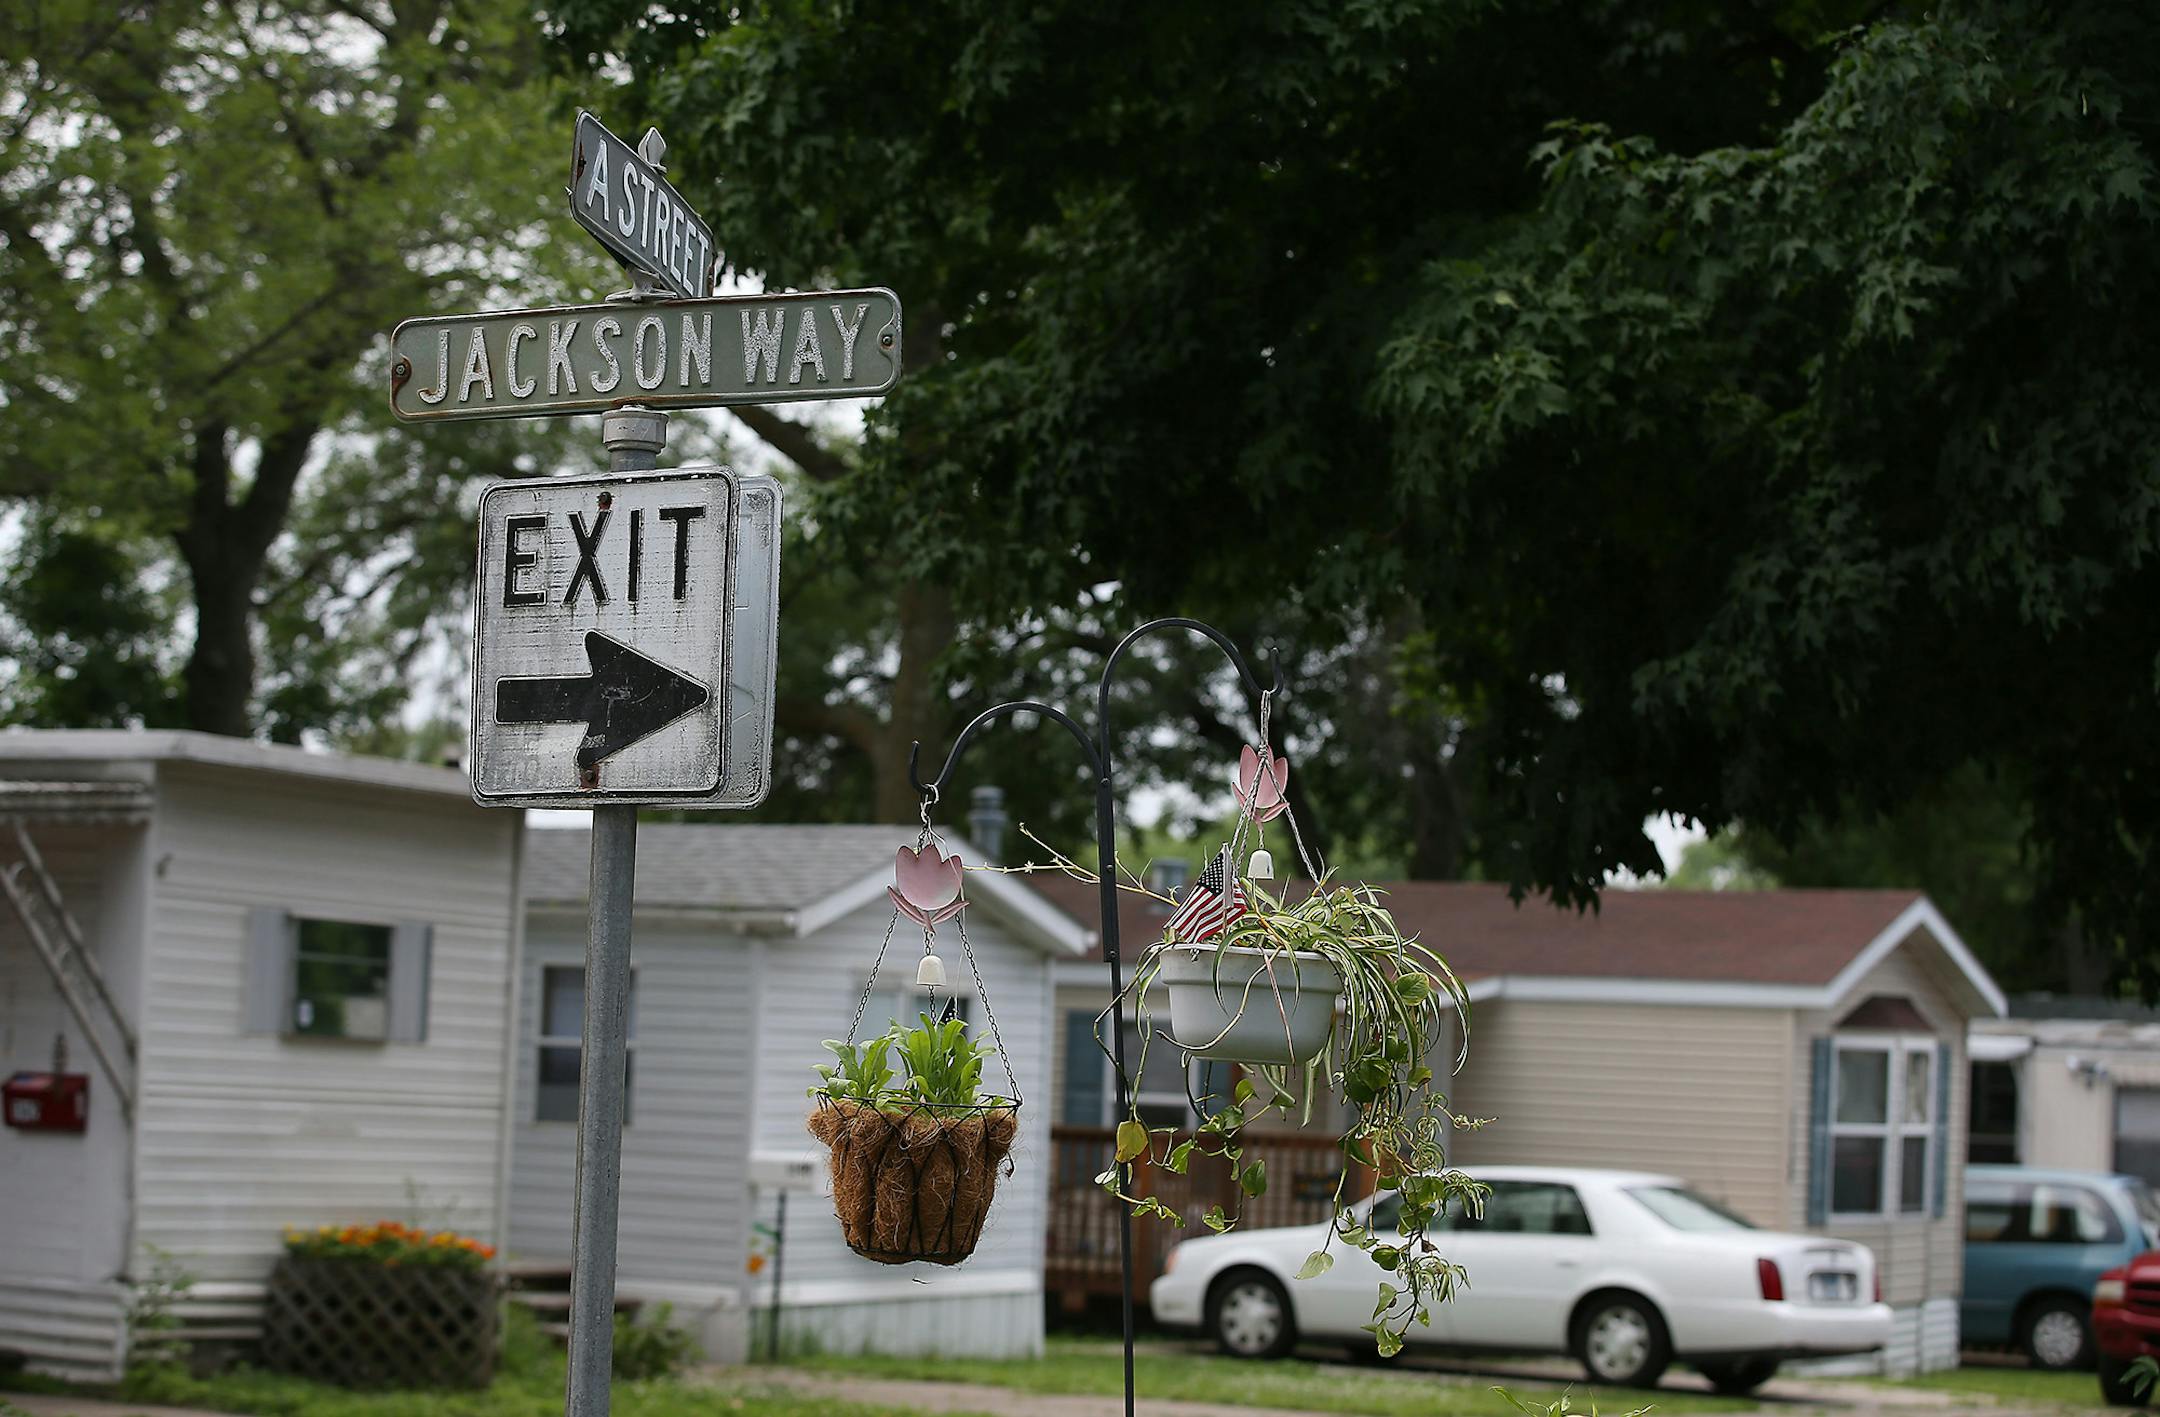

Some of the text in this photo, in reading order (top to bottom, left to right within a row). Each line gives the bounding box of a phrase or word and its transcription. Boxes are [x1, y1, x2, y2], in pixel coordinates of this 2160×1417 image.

[586, 138, 710, 297] A STREET
[417, 303, 870, 404] JACKSON WAY
[503, 506, 706, 607] EXIT
